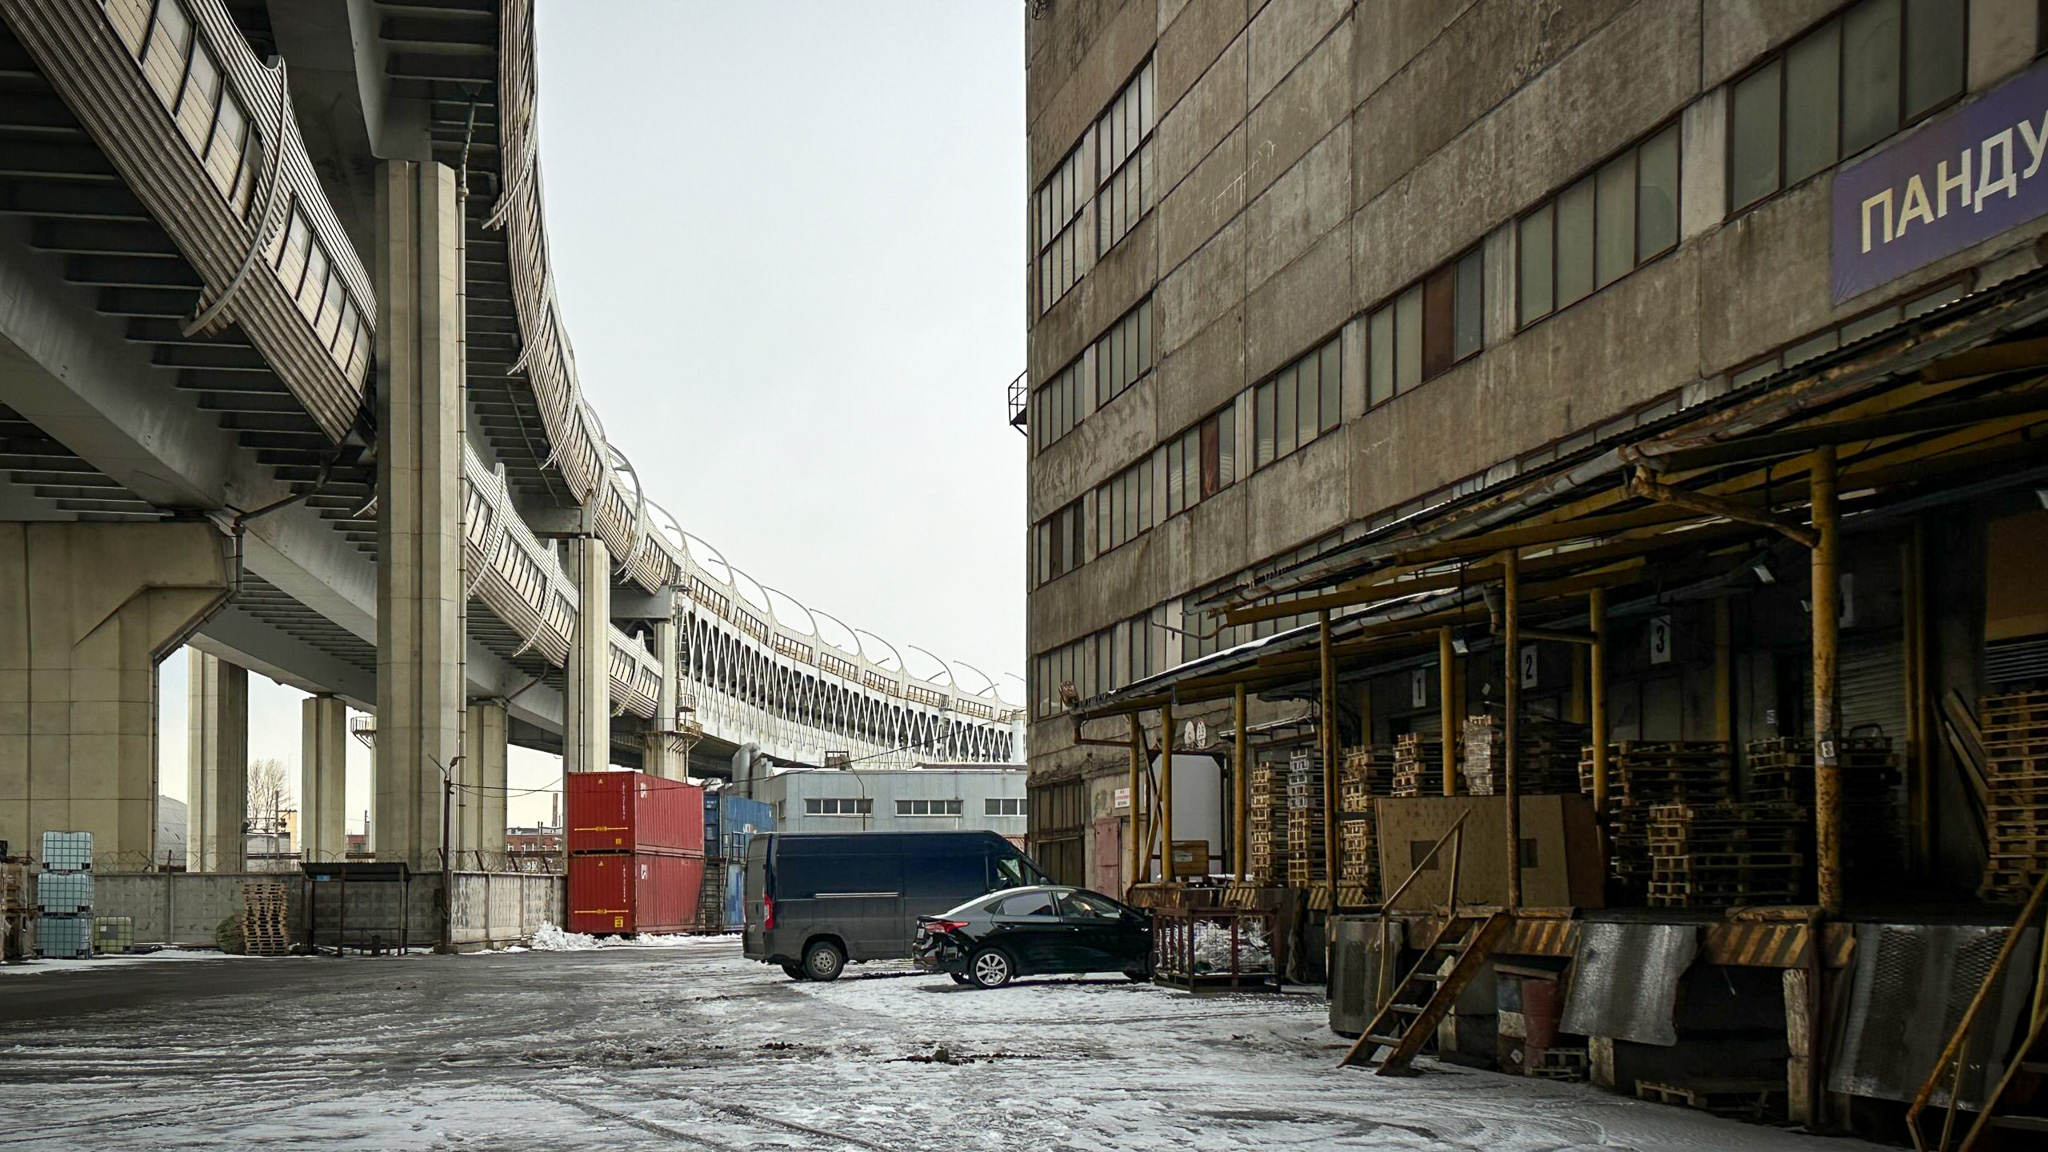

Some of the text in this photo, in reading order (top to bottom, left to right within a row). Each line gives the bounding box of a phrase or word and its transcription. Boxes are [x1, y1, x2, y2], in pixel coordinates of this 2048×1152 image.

[1861, 109, 2048, 254] ПАНДУ
[1656, 624, 1665, 654] 3
[1525, 654, 1533, 680] 2
